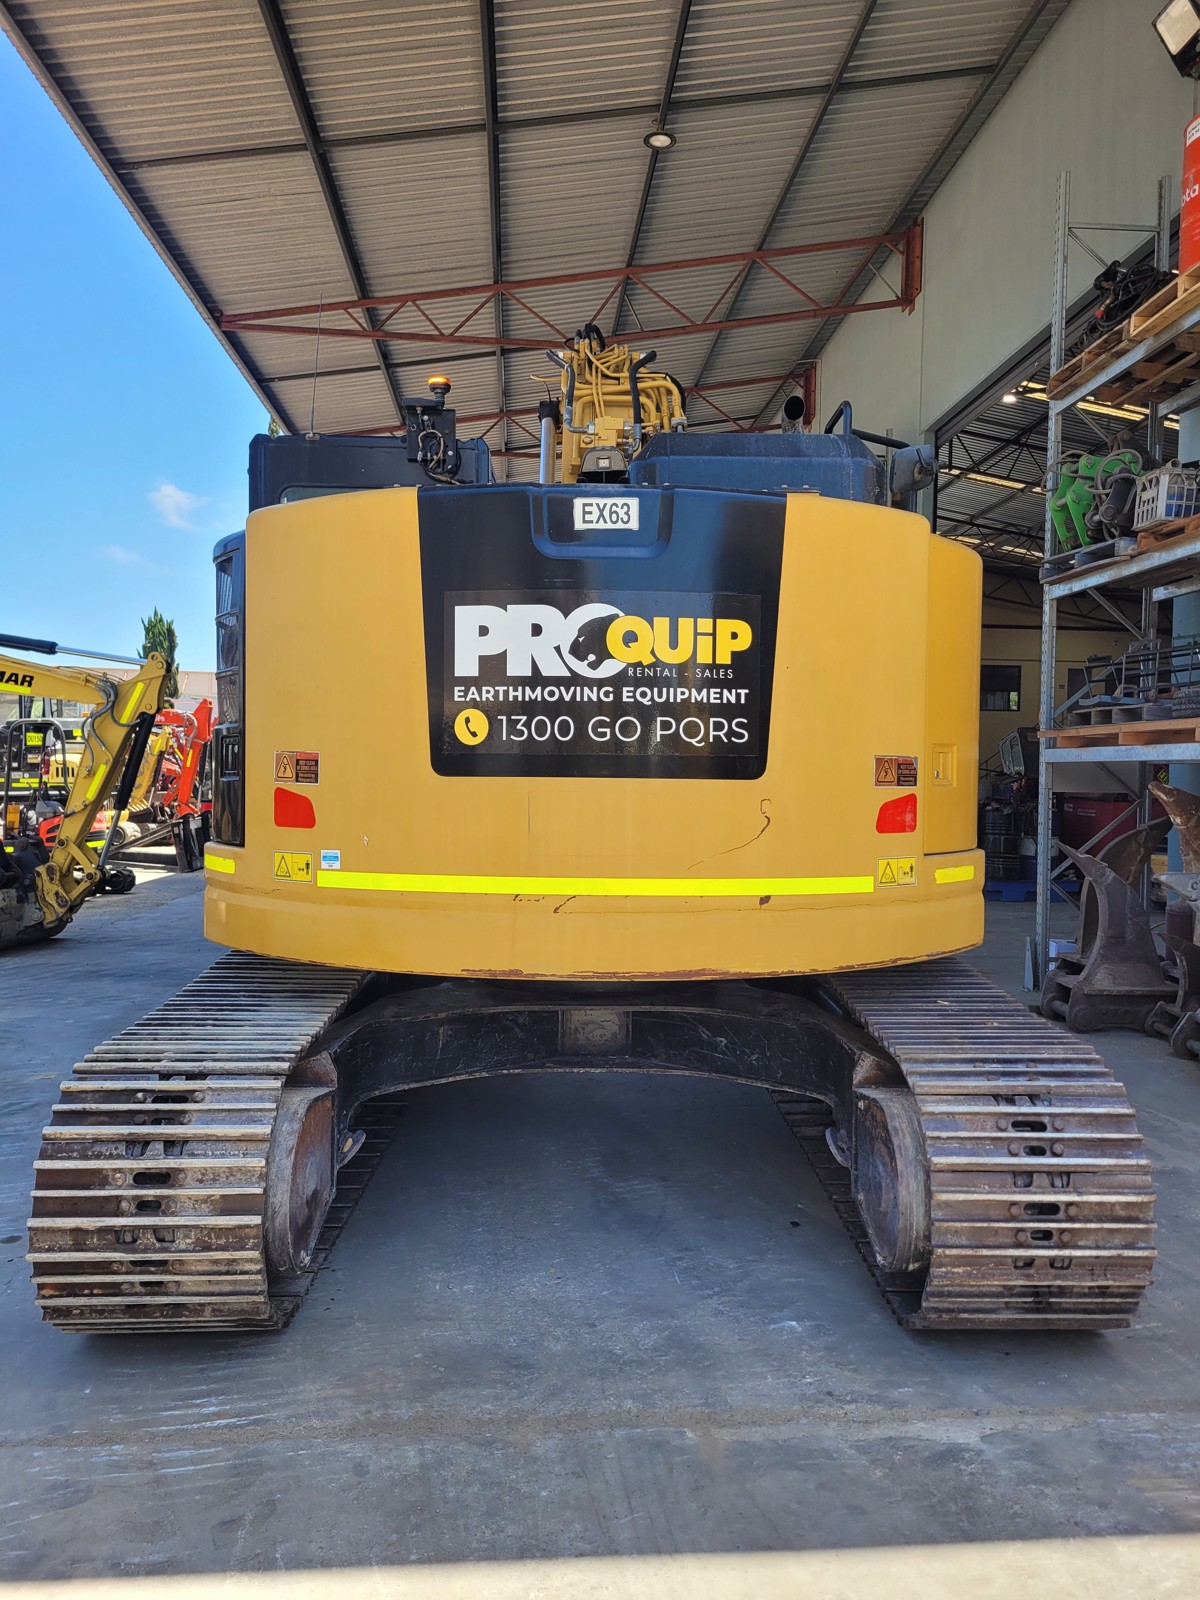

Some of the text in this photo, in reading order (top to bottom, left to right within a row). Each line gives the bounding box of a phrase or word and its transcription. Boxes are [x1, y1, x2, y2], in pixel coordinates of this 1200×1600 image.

[581, 502, 631, 525] EX63
[628, 667, 678, 678] RENTAL
[695, 667, 734, 679] SALES
[453, 686, 749, 705] EARTHMOVING EQUIPMENT
[497, 715, 749, 747] 1300 GO PQRS
